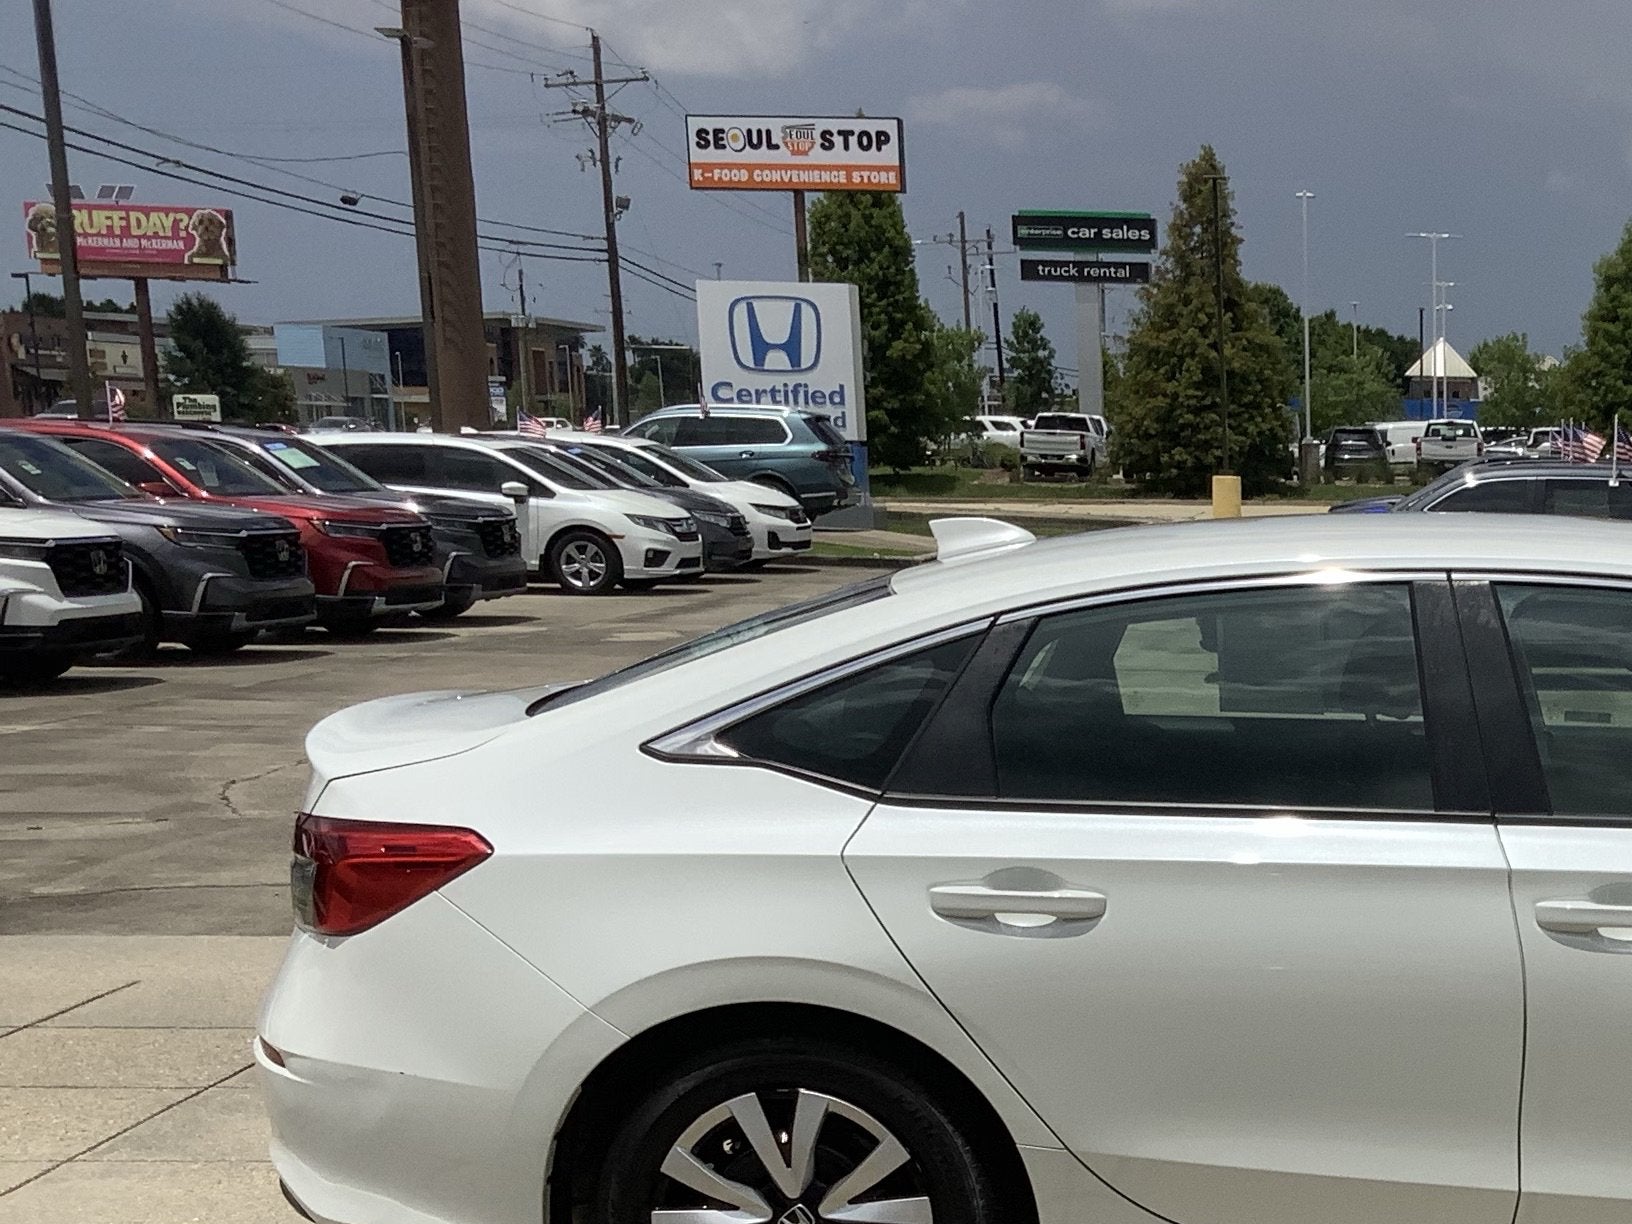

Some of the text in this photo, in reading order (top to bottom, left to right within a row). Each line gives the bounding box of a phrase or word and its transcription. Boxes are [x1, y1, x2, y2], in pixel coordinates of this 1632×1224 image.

[695, 126, 891, 152] SEOUL STOP
[693, 168, 896, 184] K-FOOD CONVENIENCE STORE
[129, 210, 189, 238] DAY?
[1019, 225, 1150, 240] enterprise car sales
[122, 238, 140, 249] AND
[1037, 263, 1130, 278] truck rental
[710, 381, 846, 406] Certified
